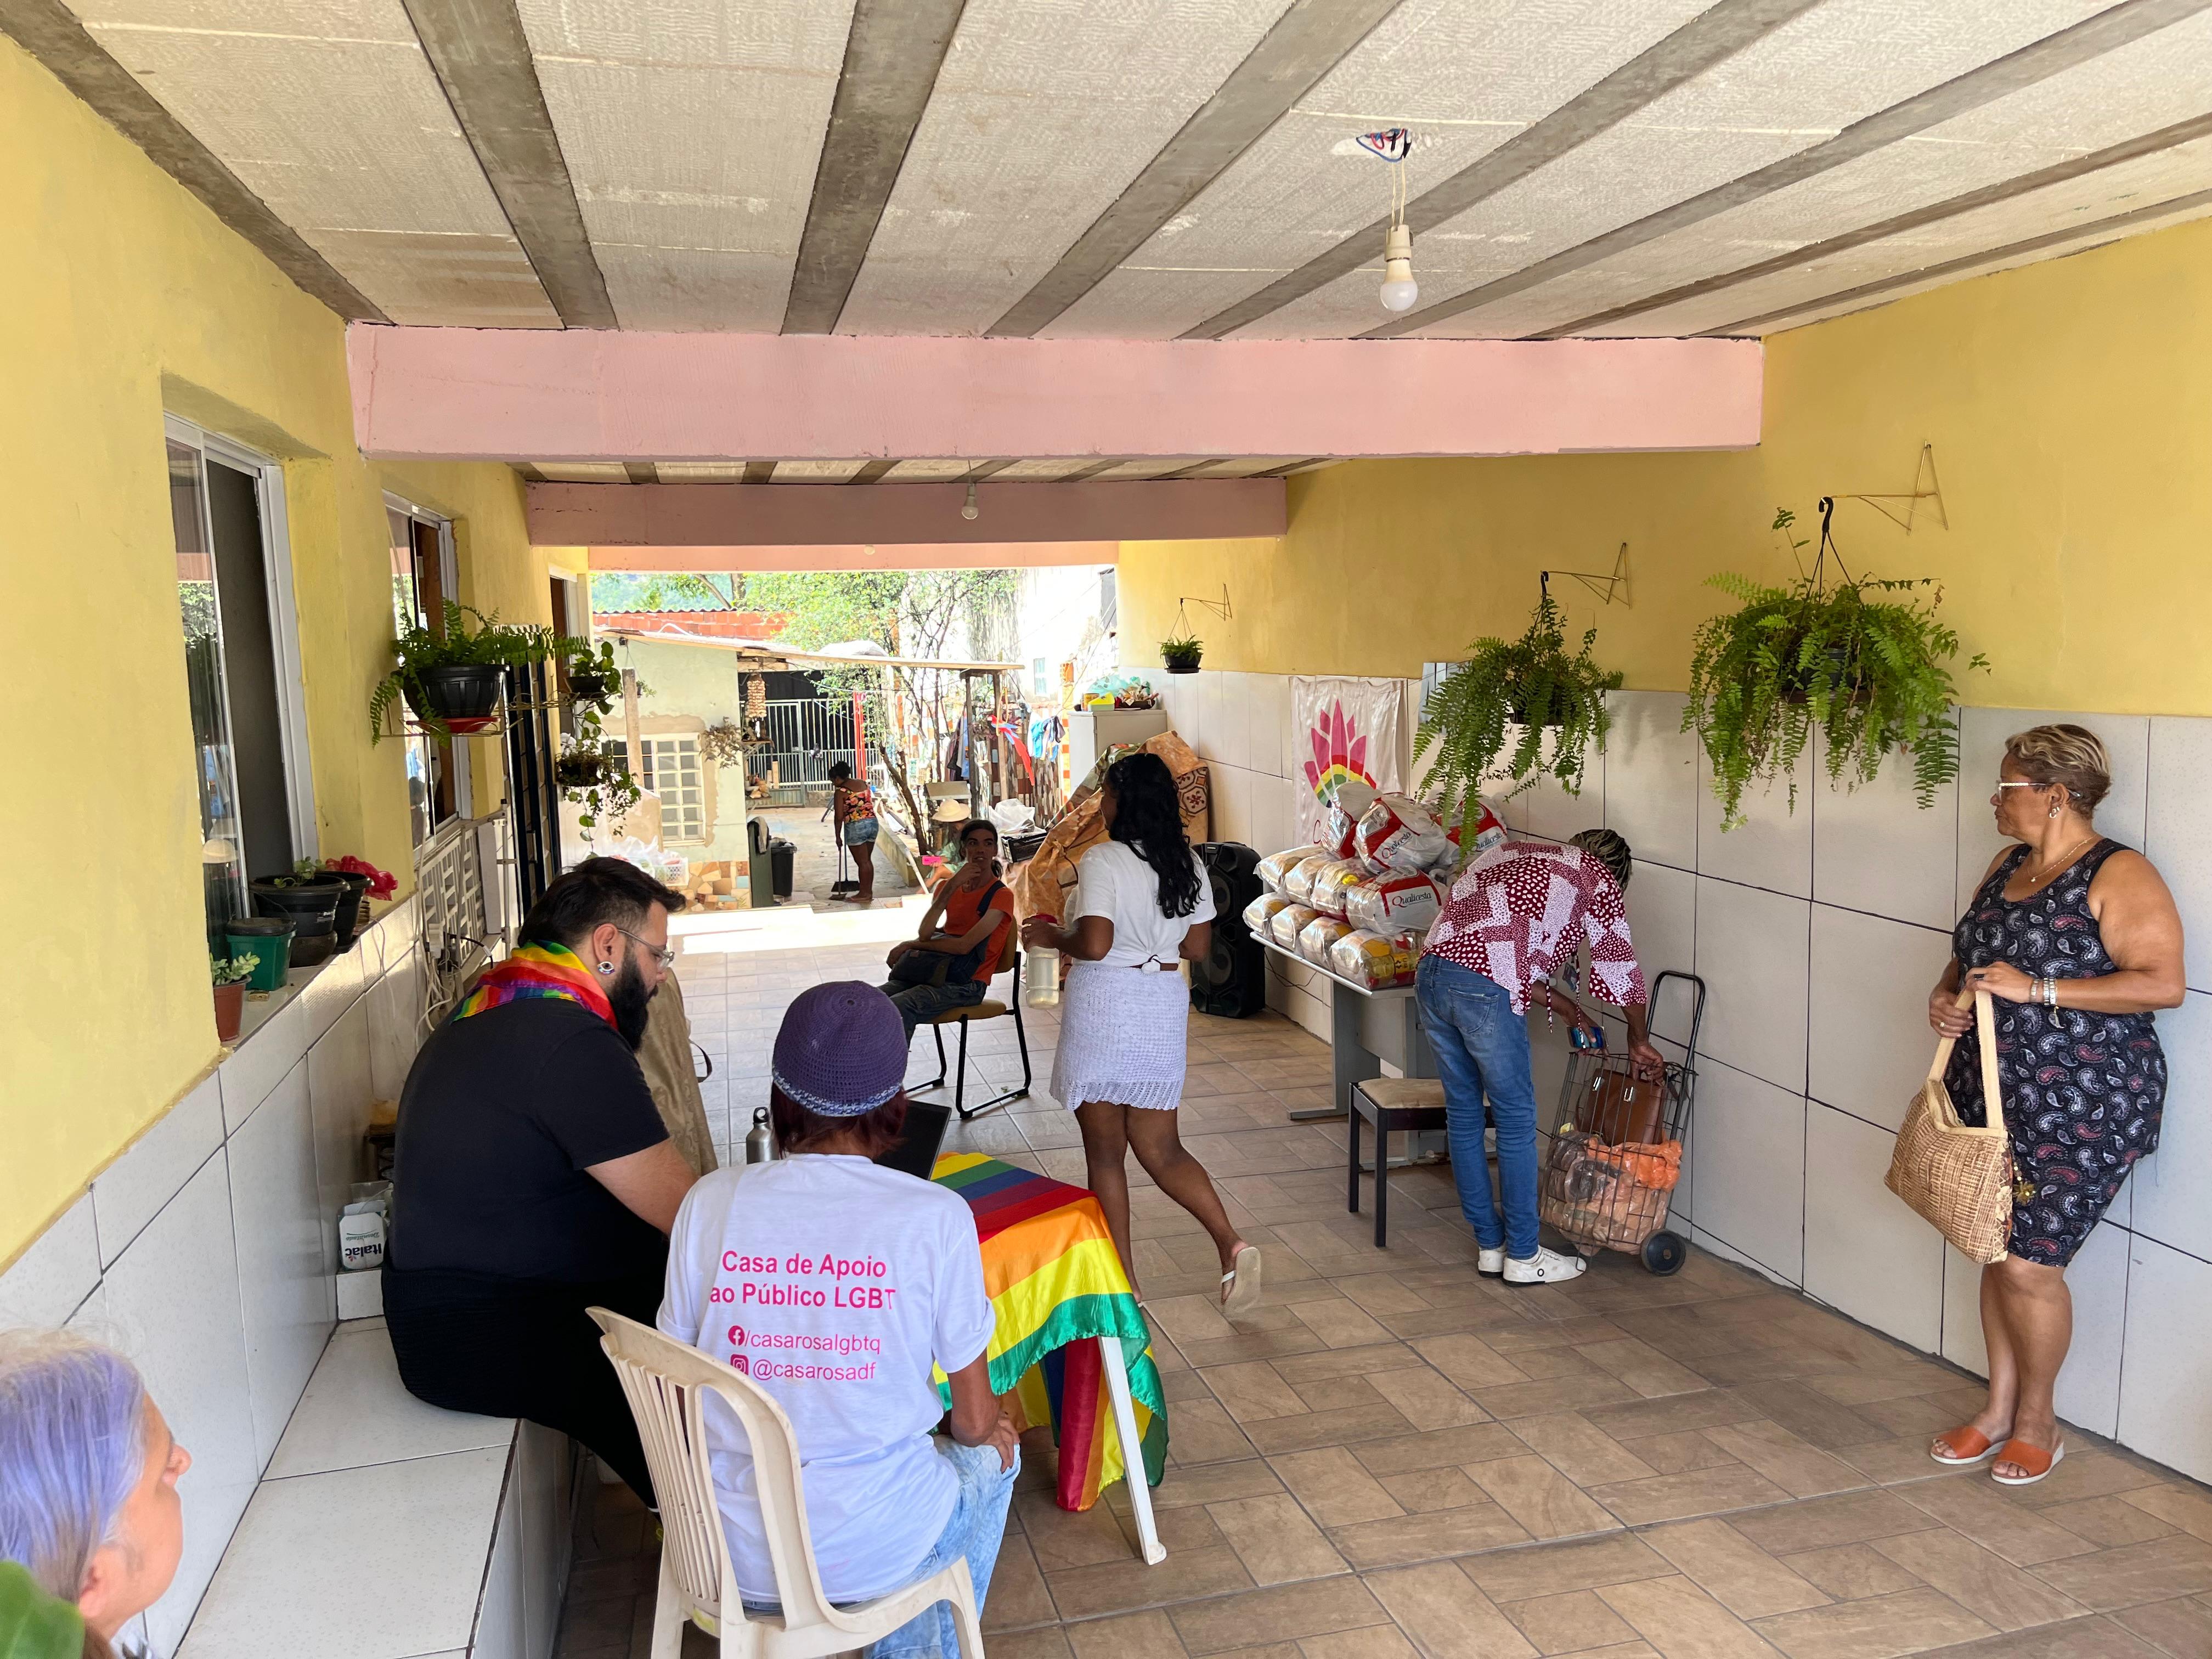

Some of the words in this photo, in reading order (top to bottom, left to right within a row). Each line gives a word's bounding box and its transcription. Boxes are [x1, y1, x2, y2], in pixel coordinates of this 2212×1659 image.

[1392, 891, 1432, 908] Qualicesta
[345, 1243, 382, 1257] Italac
[722, 1250, 778, 1273] Casa
[786, 1253, 813, 1275] de
[819, 1253, 887, 1281] Apoio
[709, 1287, 736, 1304] ao
[742, 1282, 826, 1307] Público
[834, 1286, 896, 1310] LGBT
[753, 1359, 876, 1381] @casarosadf
